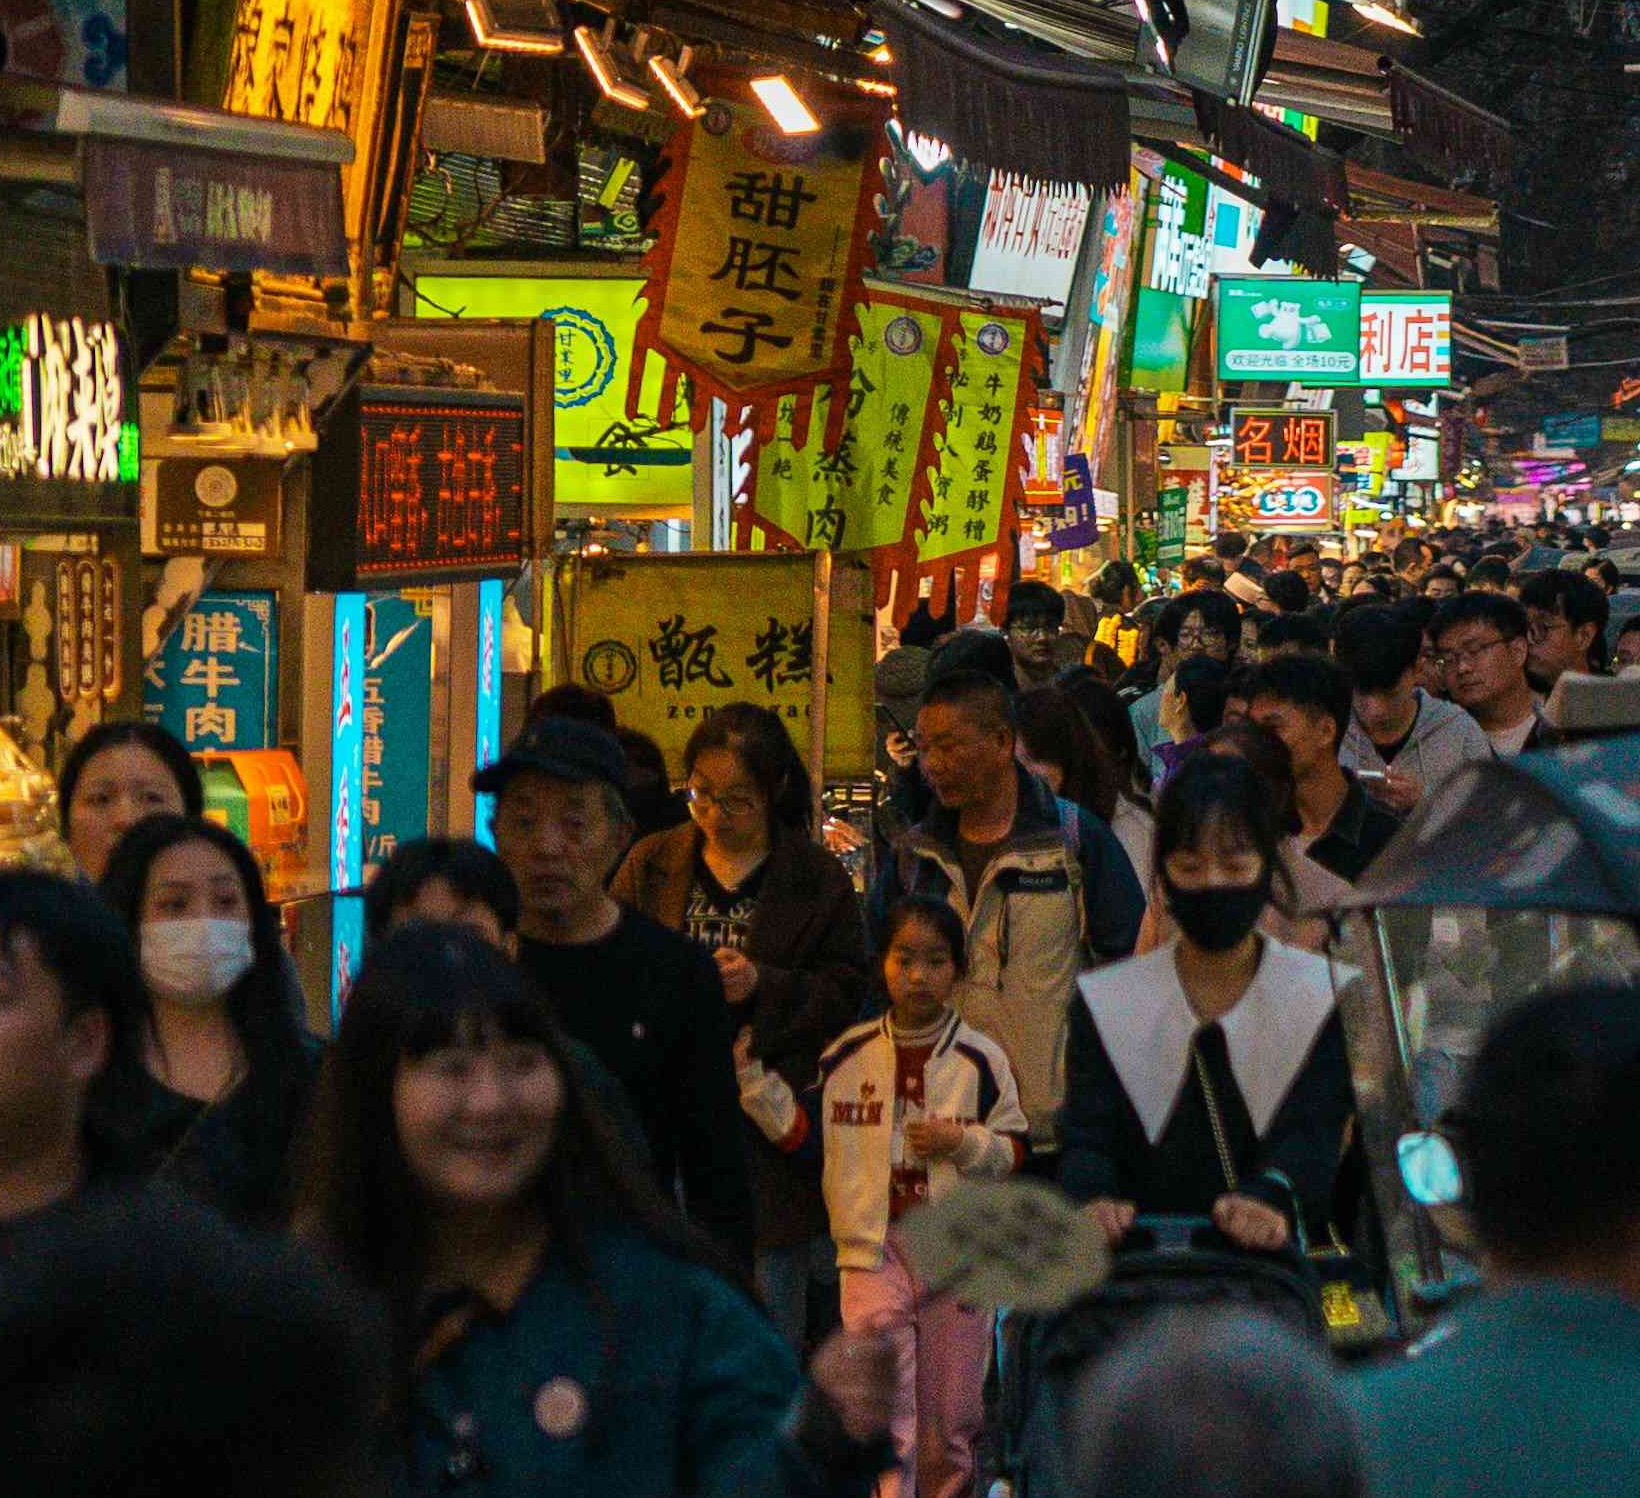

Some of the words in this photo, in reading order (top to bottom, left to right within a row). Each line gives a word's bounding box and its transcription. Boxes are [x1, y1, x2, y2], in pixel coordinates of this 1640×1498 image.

[699, 169, 819, 365] 甜胚子
[1230, 353, 1289, 372] 欢迎光临
[1360, 306, 1434, 373] 利店
[1238, 414, 1326, 465] 名烟
[179, 612, 242, 744] 腊牛肉
[648, 612, 834, 695] 甑糕
